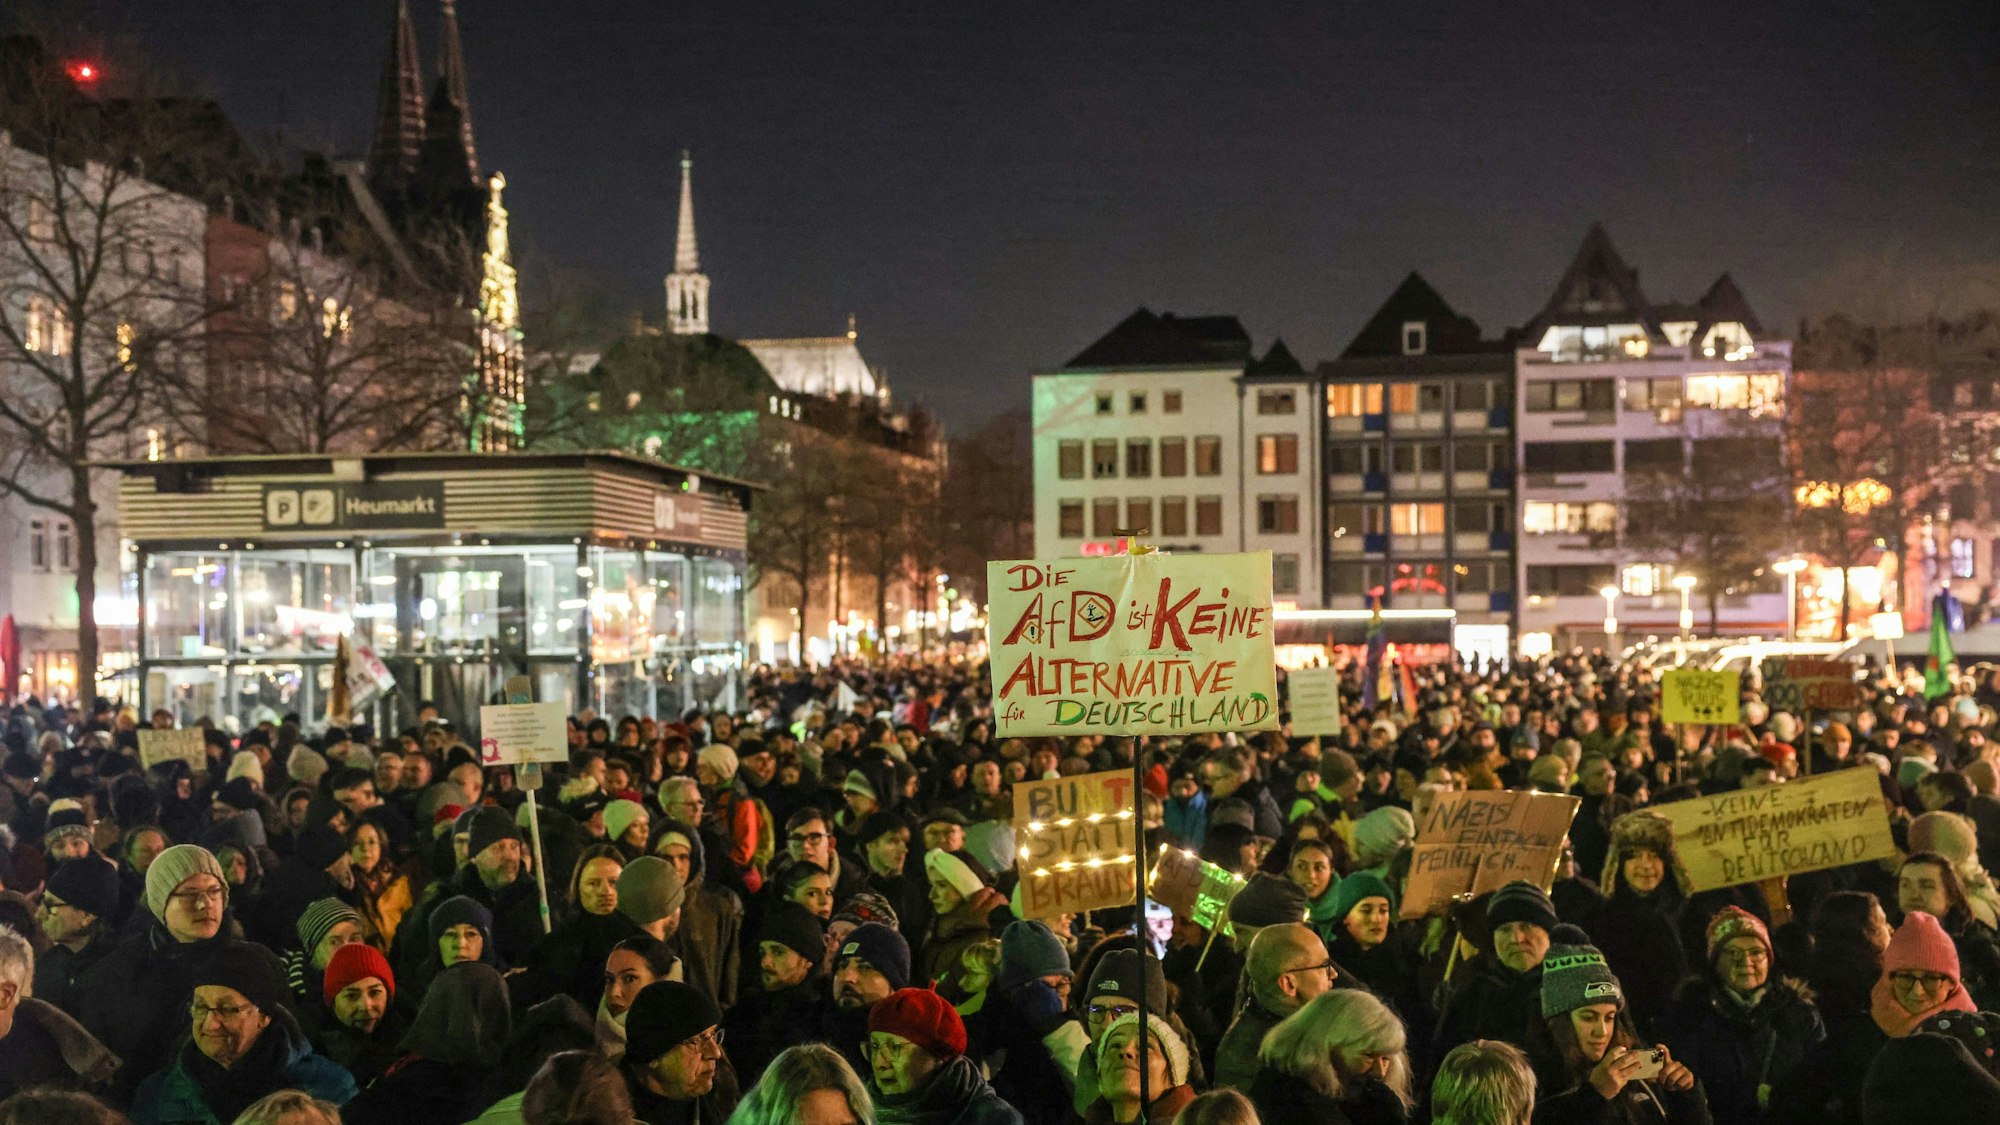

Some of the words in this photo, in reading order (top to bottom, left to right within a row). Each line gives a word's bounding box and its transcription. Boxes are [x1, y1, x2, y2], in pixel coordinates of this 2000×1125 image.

[346, 495, 436, 515] Heumarkt
[1002, 590, 1117, 649] AfD
[1127, 600, 1153, 631] ist
[1046, 692, 1270, 730] DEUTSCHLAND
[1027, 777, 1132, 820] BUNT
[1427, 800, 1512, 833] NAZIS
[1032, 819, 1124, 860] STATT
[1722, 835, 1867, 881] DEUTSCHLAND
[1030, 867, 1134, 913] BRAUN
